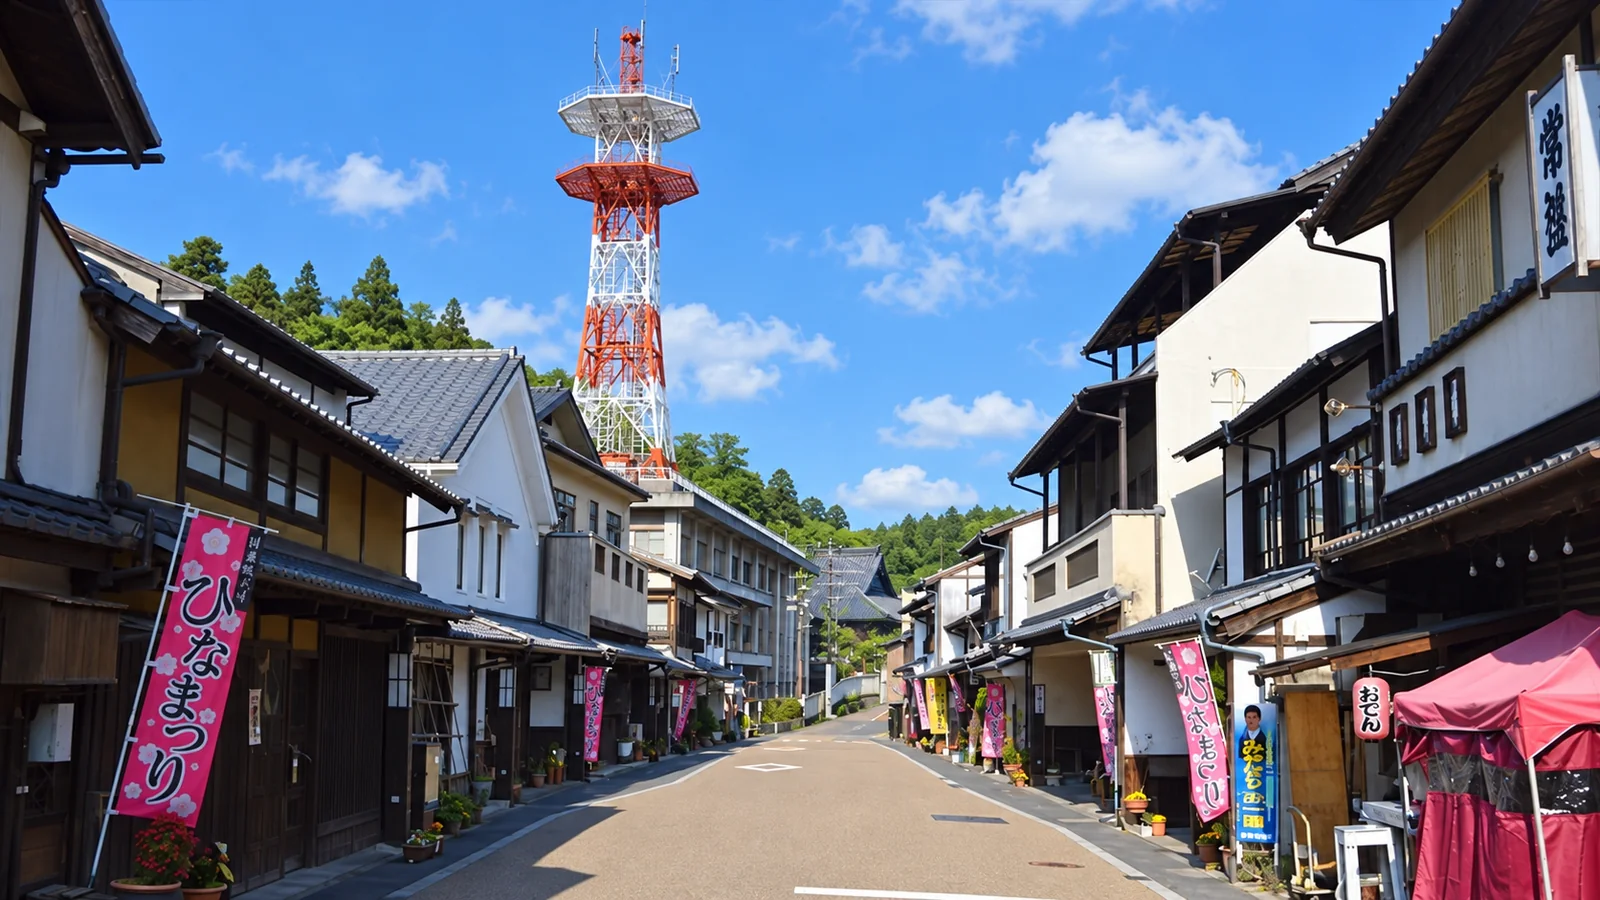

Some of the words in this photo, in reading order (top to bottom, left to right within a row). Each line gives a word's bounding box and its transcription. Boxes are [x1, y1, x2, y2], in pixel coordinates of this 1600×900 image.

[145, 576, 234, 804] ひなまつり
[1359, 686, 1381, 732] おでん
